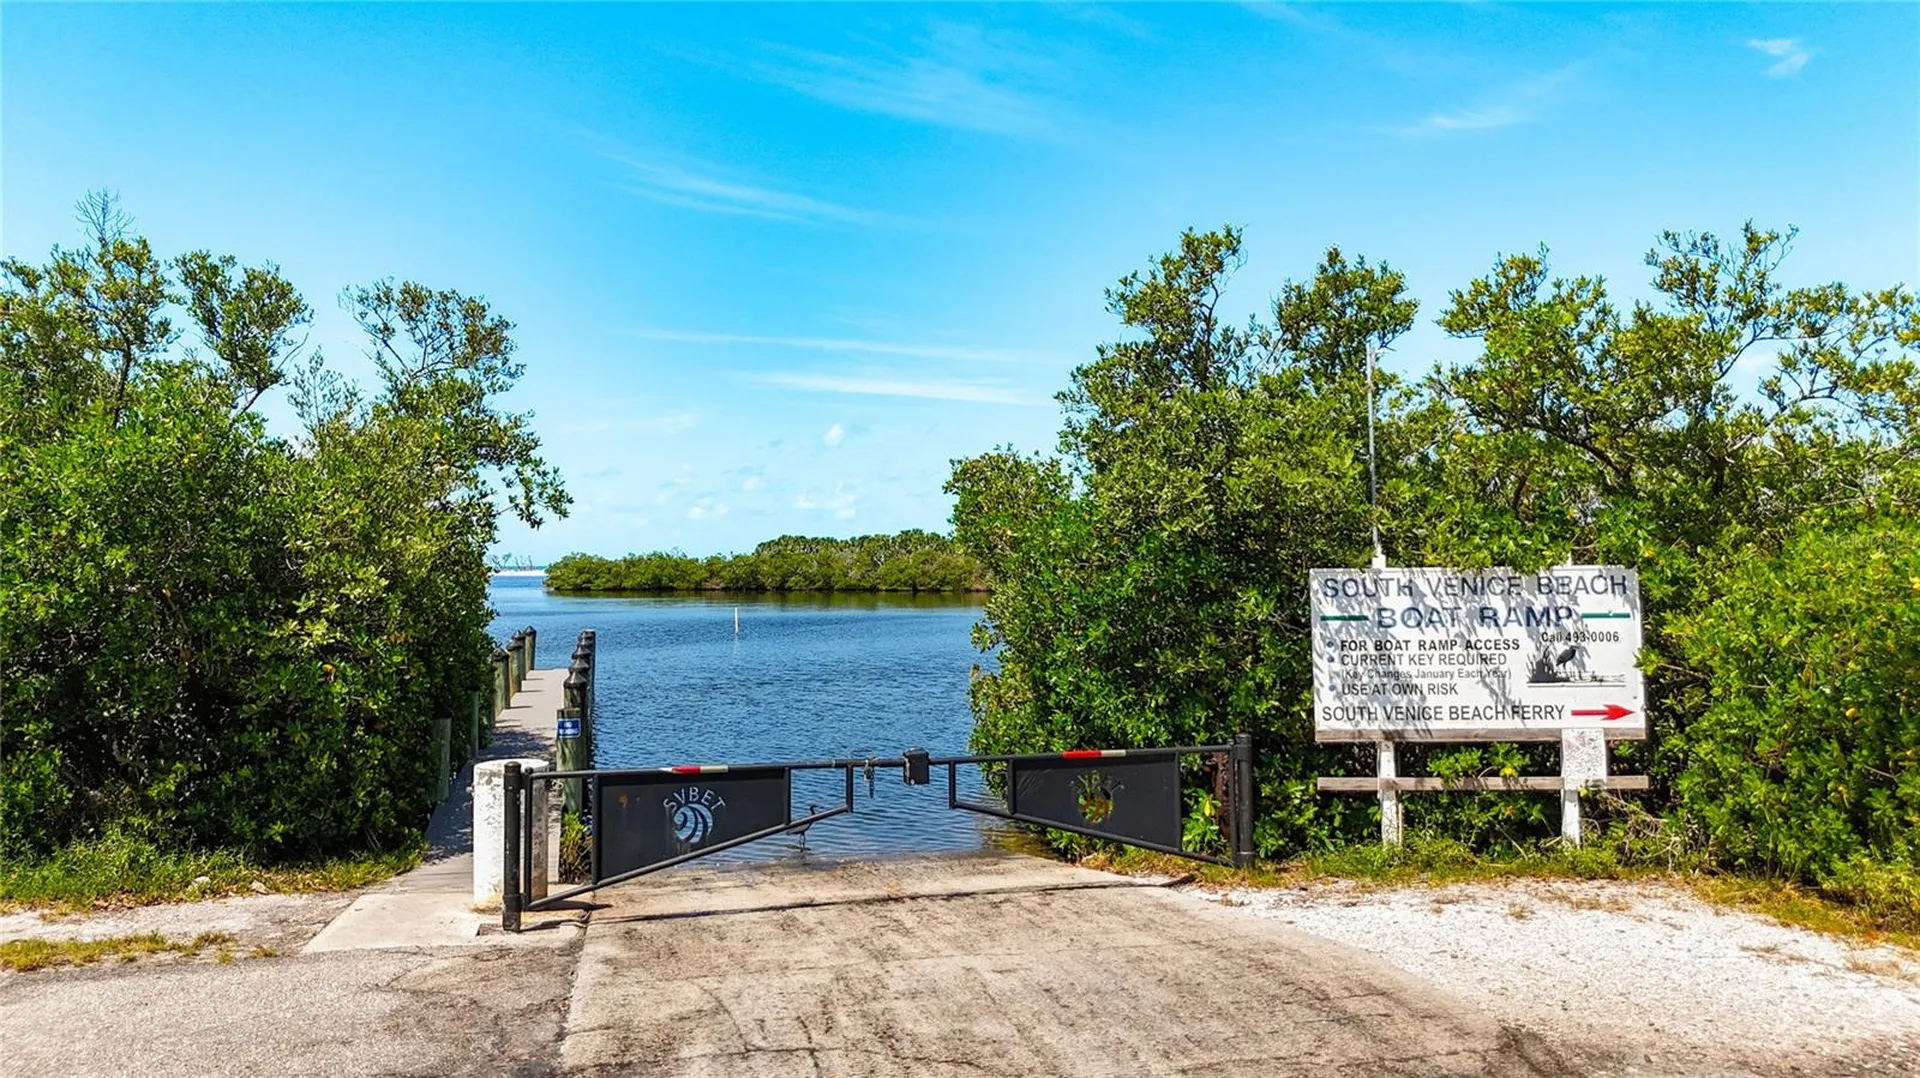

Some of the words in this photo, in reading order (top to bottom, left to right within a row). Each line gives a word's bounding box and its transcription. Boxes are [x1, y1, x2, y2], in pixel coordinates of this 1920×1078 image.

[1322, 577, 1414, 598] SOUTH
[1427, 575, 1522, 597] VENICE
[1537, 574, 1628, 596] BEACH
[1377, 606, 1463, 629] BOAT
[1479, 605, 1573, 628] RAMP
[1541, 631, 1563, 643] Call
[1565, 631, 1620, 643] 493-0006
[1340, 640, 1368, 652] FOR
[1374, 640, 1412, 652] BOAT
[1418, 639, 1458, 652] RAMP
[1464, 639, 1520, 651] ACCESS
[1341, 654, 1404, 667] CURRENT
[1408, 653, 1435, 666] KEY
[1438, 653, 1507, 666] REQUIRED
[1367, 669, 1412, 681] Changes
[1414, 669, 1454, 680] January
[1457, 669, 1482, 679] Each
[1342, 684, 1368, 696] USE
[1371, 684, 1387, 695] AT
[1391, 683, 1423, 696] OWN
[1427, 683, 1458, 695] RISK
[1322, 706, 1378, 721] SOUTH
[1383, 706, 1444, 721] VENICE
[1449, 705, 1506, 720] BEACH
[1510, 705, 1565, 720] FERRY
[663, 786, 727, 813] SVBET
